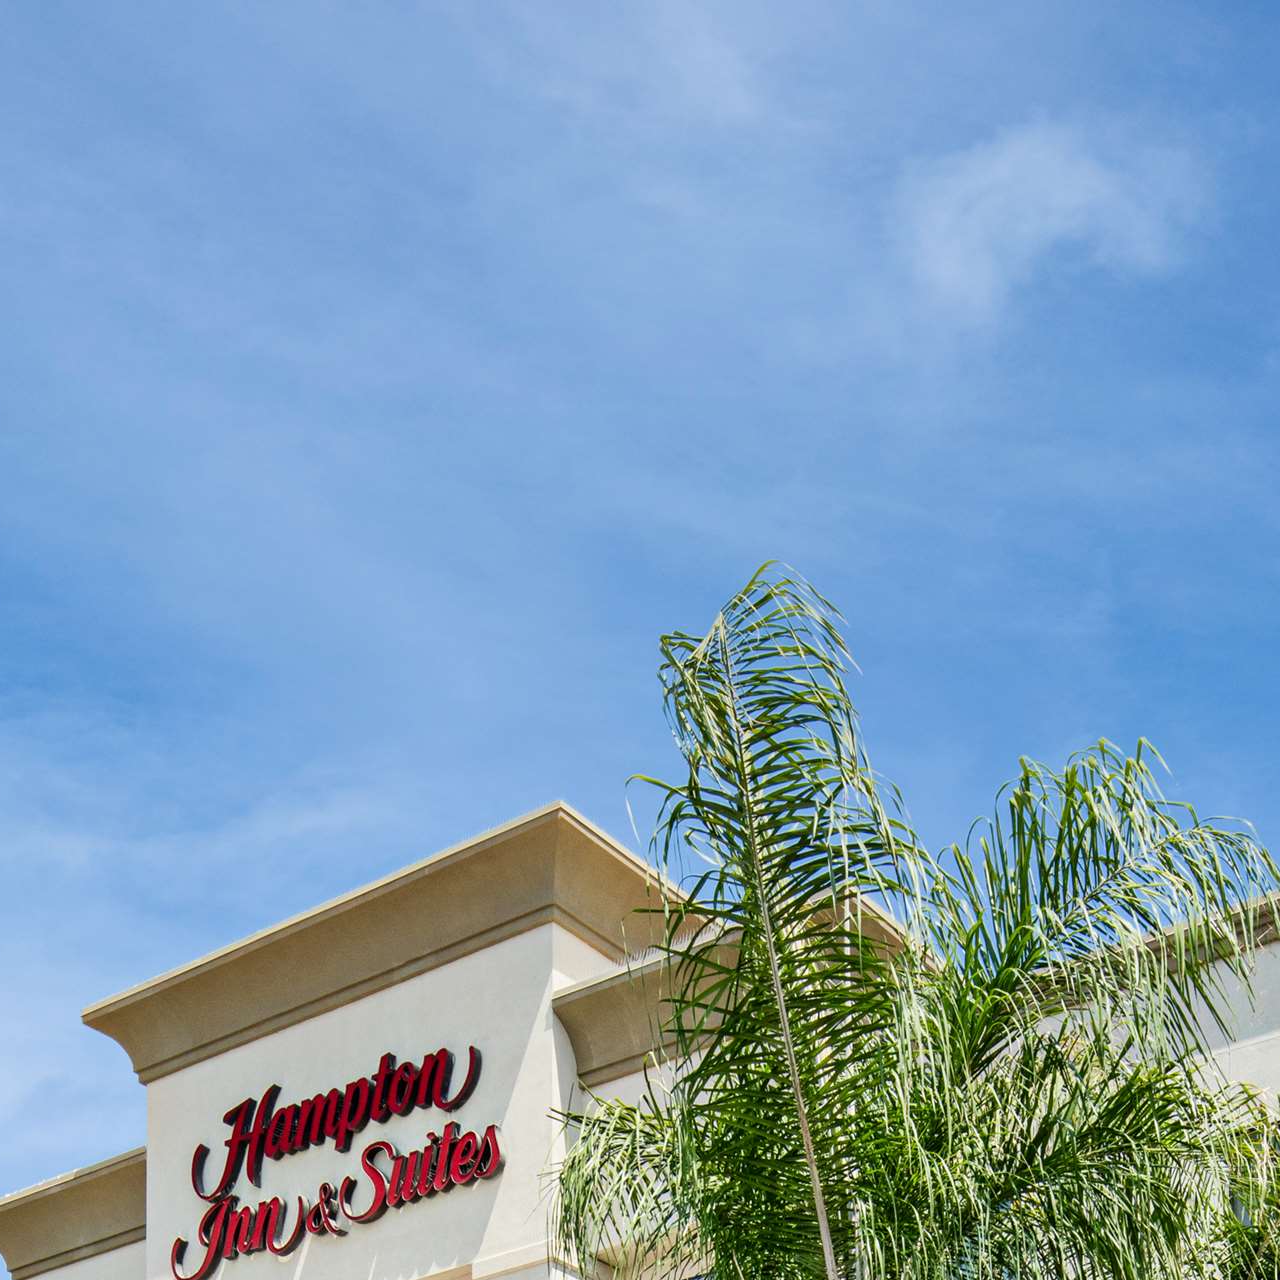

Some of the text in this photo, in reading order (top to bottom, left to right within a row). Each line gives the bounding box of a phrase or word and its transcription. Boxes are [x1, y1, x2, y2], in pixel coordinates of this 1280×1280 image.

[191, 1045, 483, 1203] Hampton
[305, 1182, 351, 1237] &
[338, 1120, 506, 1224] Suites
